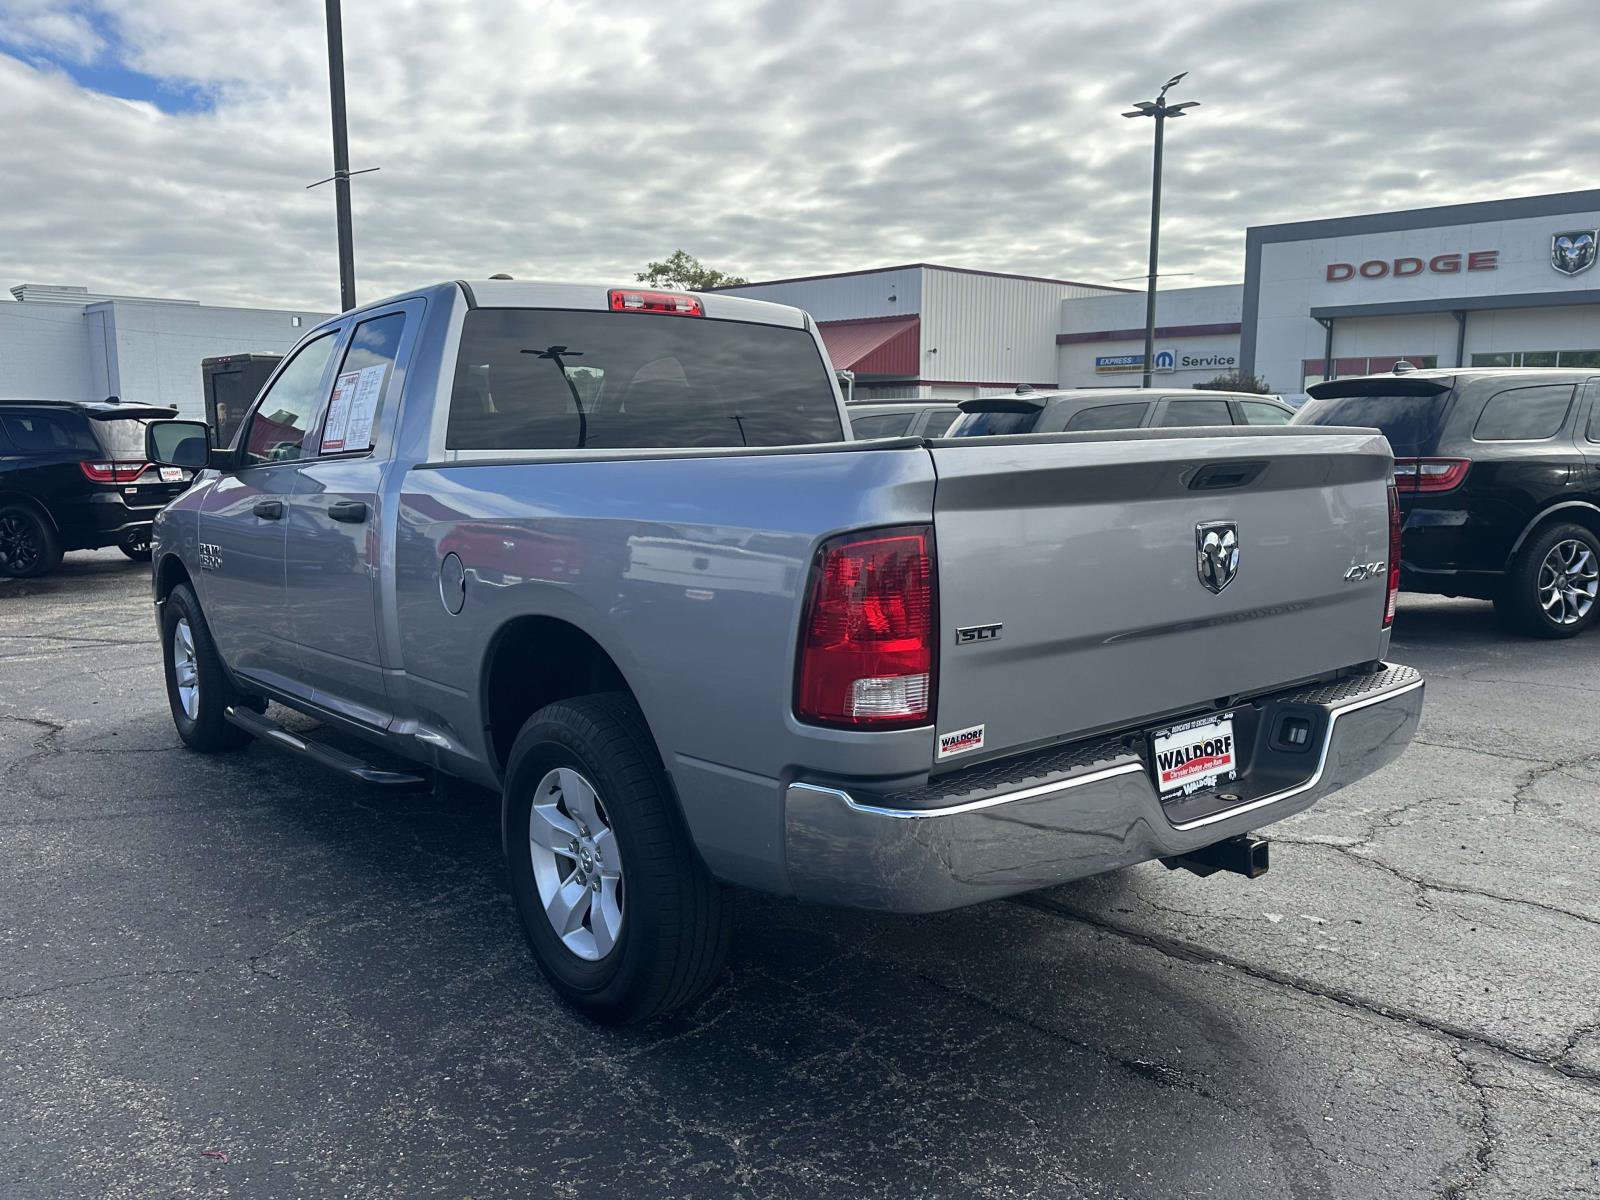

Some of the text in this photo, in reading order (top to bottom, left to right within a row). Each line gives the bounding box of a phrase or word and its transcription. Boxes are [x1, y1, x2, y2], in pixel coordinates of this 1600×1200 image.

[1326, 250, 1499, 282] DODGE
[1100, 357, 1132, 365] EXPRESS
[1182, 355, 1235, 367] Service
[961, 625, 1002, 641] SLT
[941, 729, 982, 747] WALDORF
[1157, 736, 1231, 771] WALDORF
[1170, 767, 1188, 779] Chrysler
[1188, 764, 1202, 773] Dodge
[1213, 758, 1223, 767] Ram
[1183, 776, 1217, 795] WALDORF
